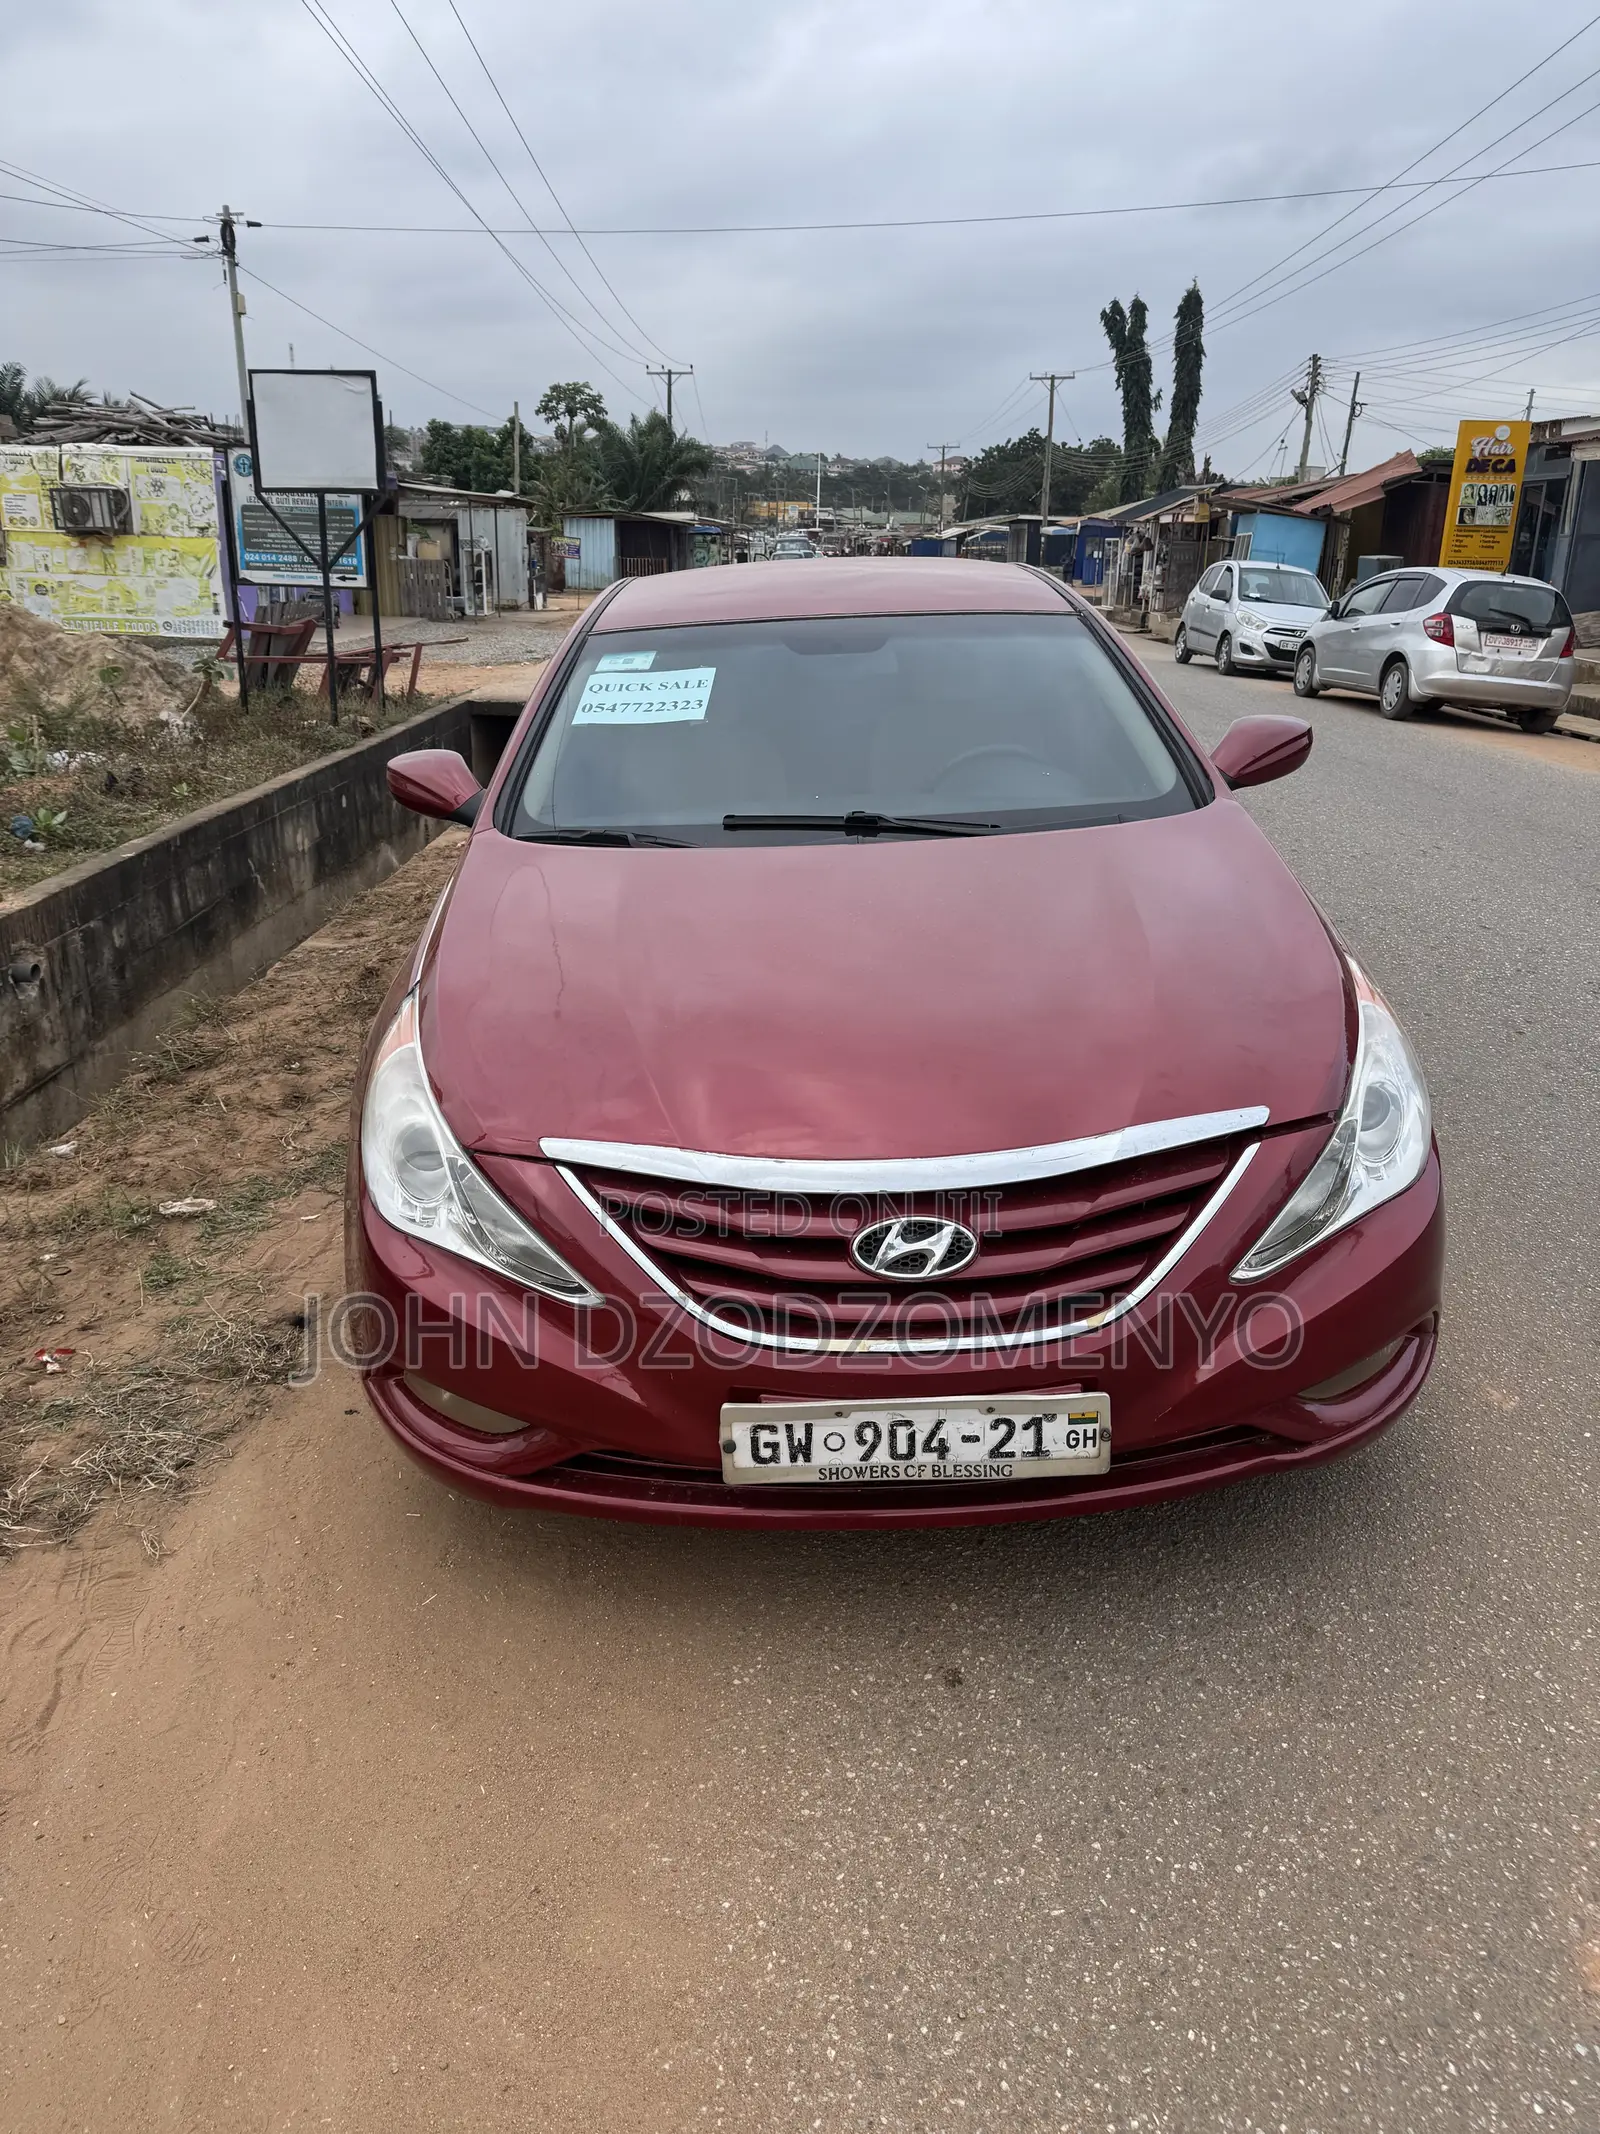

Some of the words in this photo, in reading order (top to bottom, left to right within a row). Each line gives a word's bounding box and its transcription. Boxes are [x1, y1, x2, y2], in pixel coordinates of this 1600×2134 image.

[1471, 437, 1515, 458] Hair
[1464, 459, 1516, 473] DECA
[244, 553, 259, 561] 024
[261, 554, 276, 562] 014
[278, 555, 297, 563] 2488
[124, 621, 157, 633] FOODS
[588, 682, 653, 694] QUICK
[657, 679, 709, 691] SALE
[581, 699, 704, 714] 0547722323
[750, 1422, 814, 1465] GW
[1065, 1428, 1098, 1450] GH
[817, 1464, 902, 1481] SHOWERS
[903, 1464, 928, 1478] OF
[931, 1463, 1014, 1478] BLESSING
